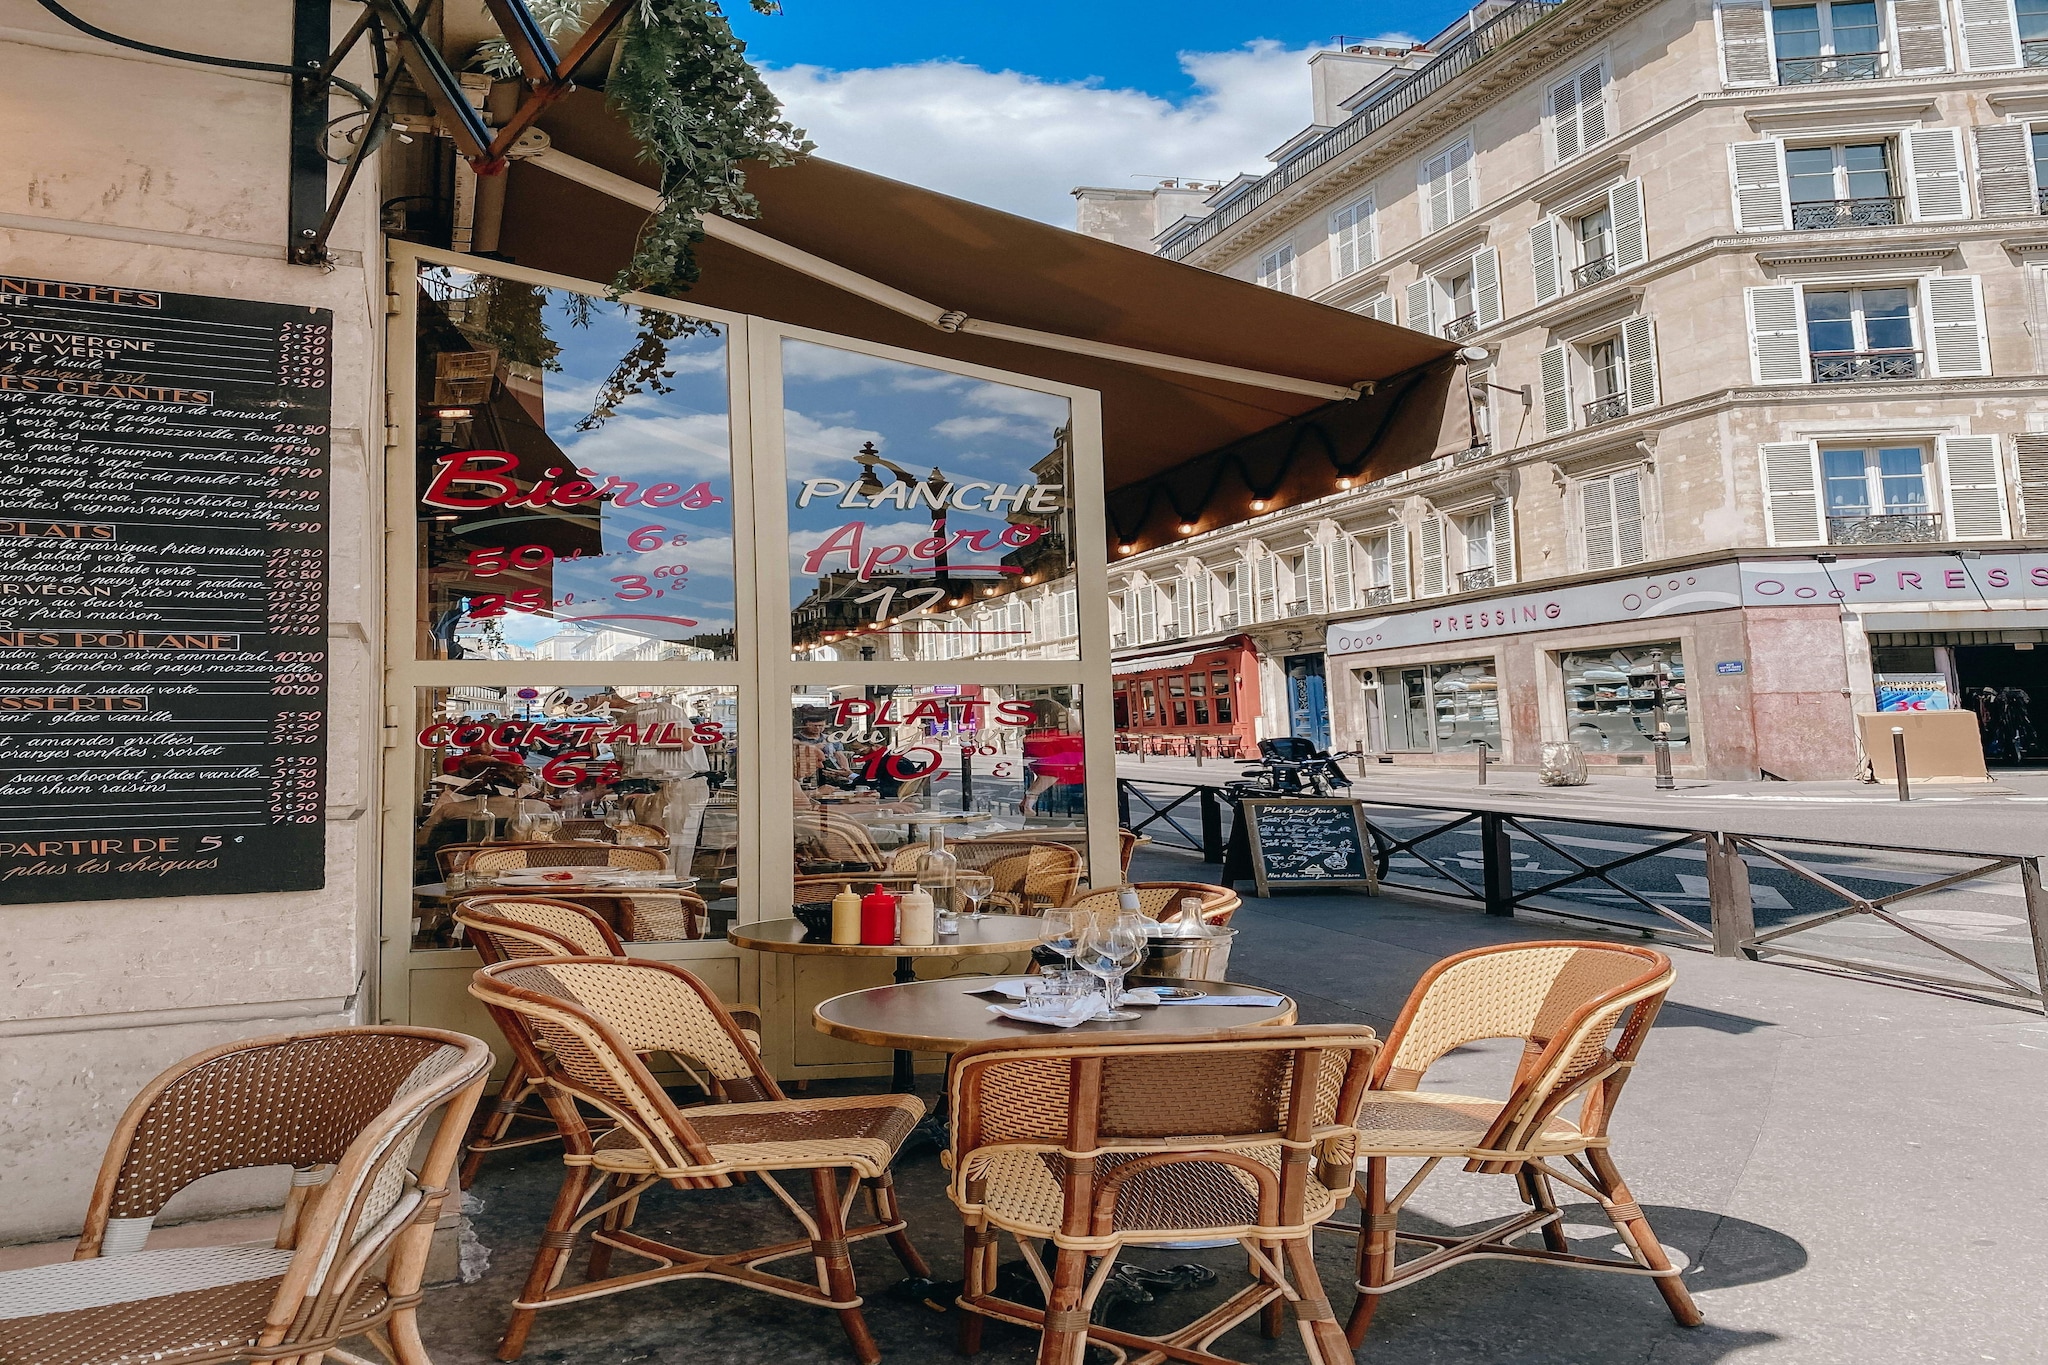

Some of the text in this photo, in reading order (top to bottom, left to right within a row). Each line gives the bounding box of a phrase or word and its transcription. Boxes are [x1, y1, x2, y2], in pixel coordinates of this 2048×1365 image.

[54, 346, 121, 359] VERT
[57, 380, 209, 404] GÉANTES
[8, 404, 88, 419] jambon
[90, 411, 114, 421] de
[117, 416, 168, 426] pays
[80, 399, 105, 408] de
[106, 399, 141, 411] foie
[143, 404, 183, 414] gras
[186, 405, 207, 416] de
[20, 428, 79, 442] olives
[66, 420, 110, 431] brick
[113, 423, 134, 433] de
[77, 443, 100, 454] de
[101, 447, 174, 459] saumon
[240, 452, 309, 466] rillettes
[88, 480, 134, 491] durs
[97, 468, 149, 480] blanc
[150, 470, 174, 482] de
[173, 474, 242, 486] poulet
[421, 450, 725, 511] Bières
[141, 493, 180, 506] pois
[252, 500, 321, 512] graines
[795, 478, 1063, 514] PLANCHE
[71, 501, 144, 515] oignons
[34, 537, 58, 549] de
[59, 537, 79, 550] la
[160, 542, 206, 556] frites
[207, 545, 266, 557] maison
[801, 518, 1051, 583] Apéro
[31, 551, 92, 561] salade
[98, 552, 137, 563] verte
[91, 563, 150, 575] salade
[155, 565, 197, 576] verte
[61, 572, 84, 584] de
[138, 578, 192, 589] grana
[196, 578, 264, 590] padano
[1853, 566, 2048, 592] PRESS
[24, 583, 111, 596] VÉGAN
[121, 586, 173, 598] frites
[176, 589, 248, 600] maison
[48, 598, 77, 608] au
[80, 597, 145, 608] beurre
[28, 607, 82, 621] frites
[85, 609, 162, 620] maison
[1432, 601, 1561, 634] PRESSING
[75, 630, 232, 649] POÎLANE
[175, 650, 269, 662] emmental
[46, 660, 126, 673] jambon
[129, 661, 152, 672] de
[94, 683, 155, 695] salade
[158, 683, 199, 695] verte
[543, 688, 627, 718] les
[48, 711, 173, 725] glace vanille
[827, 697, 1038, 729] PLATS
[26, 734, 114, 747] amandes
[417, 721, 725, 749] COCKTAILS
[827, 724, 1026, 756] du jour
[0, 749, 70, 762] oranges
[163, 745, 226, 757] sorbet
[8, 772, 65, 783] sauce
[144, 768, 195, 784] glace
[199, 767, 260, 779] vanille
[37, 782, 93, 795] rhum
[98, 781, 167, 793] raisins
[1262, 806, 1294, 814] Plats
[1308, 807, 1339, 816] Jour
[0, 840, 125, 857] PARTIR
[133, 837, 179, 853] DE
[2, 855, 219, 881] plus les chèques
